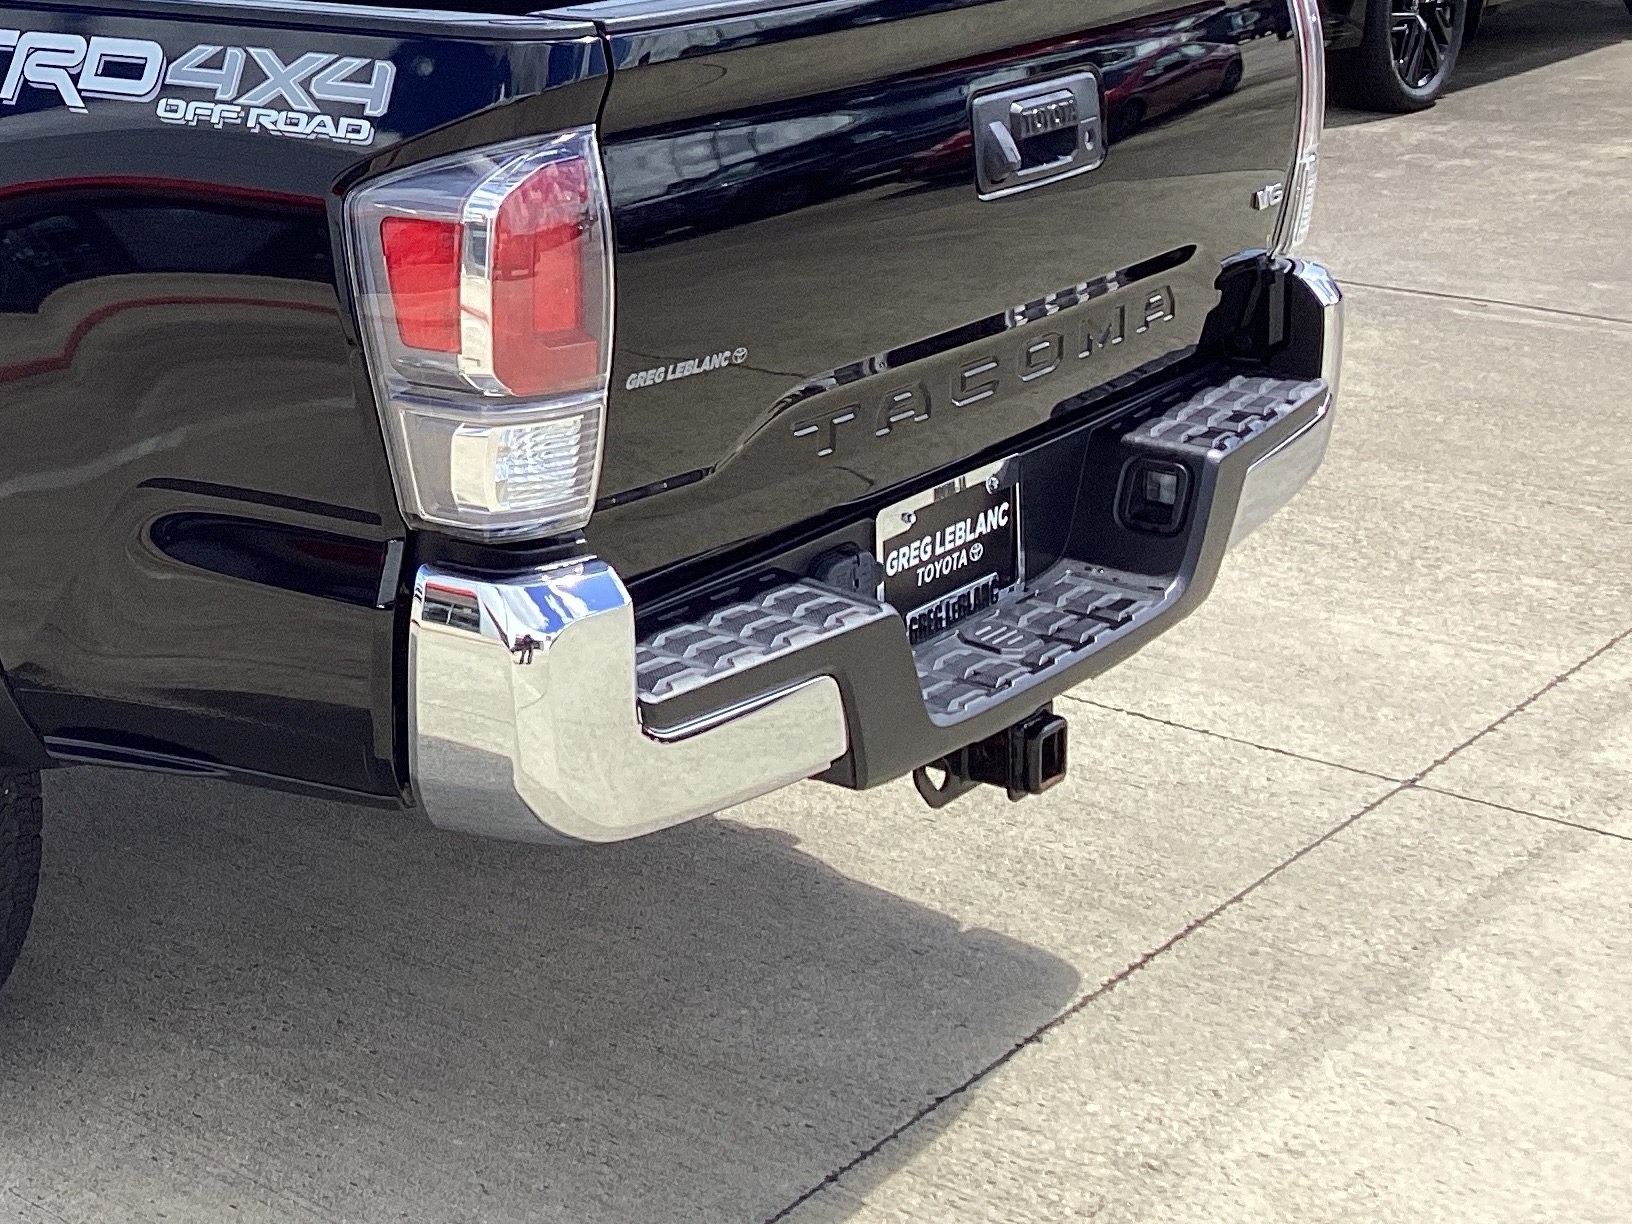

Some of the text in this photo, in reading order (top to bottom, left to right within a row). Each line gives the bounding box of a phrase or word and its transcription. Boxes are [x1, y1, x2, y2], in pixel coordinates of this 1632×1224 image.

[156, 97, 374, 145] OFF ROAD
[1252, 182, 1283, 210] V6
[625, 350, 731, 390] GREG LEBLANC
[792, 284, 1176, 457] TACOMA
[885, 501, 1010, 576] GREG LEBLANC
[916, 548, 968, 586] TOYOTA
